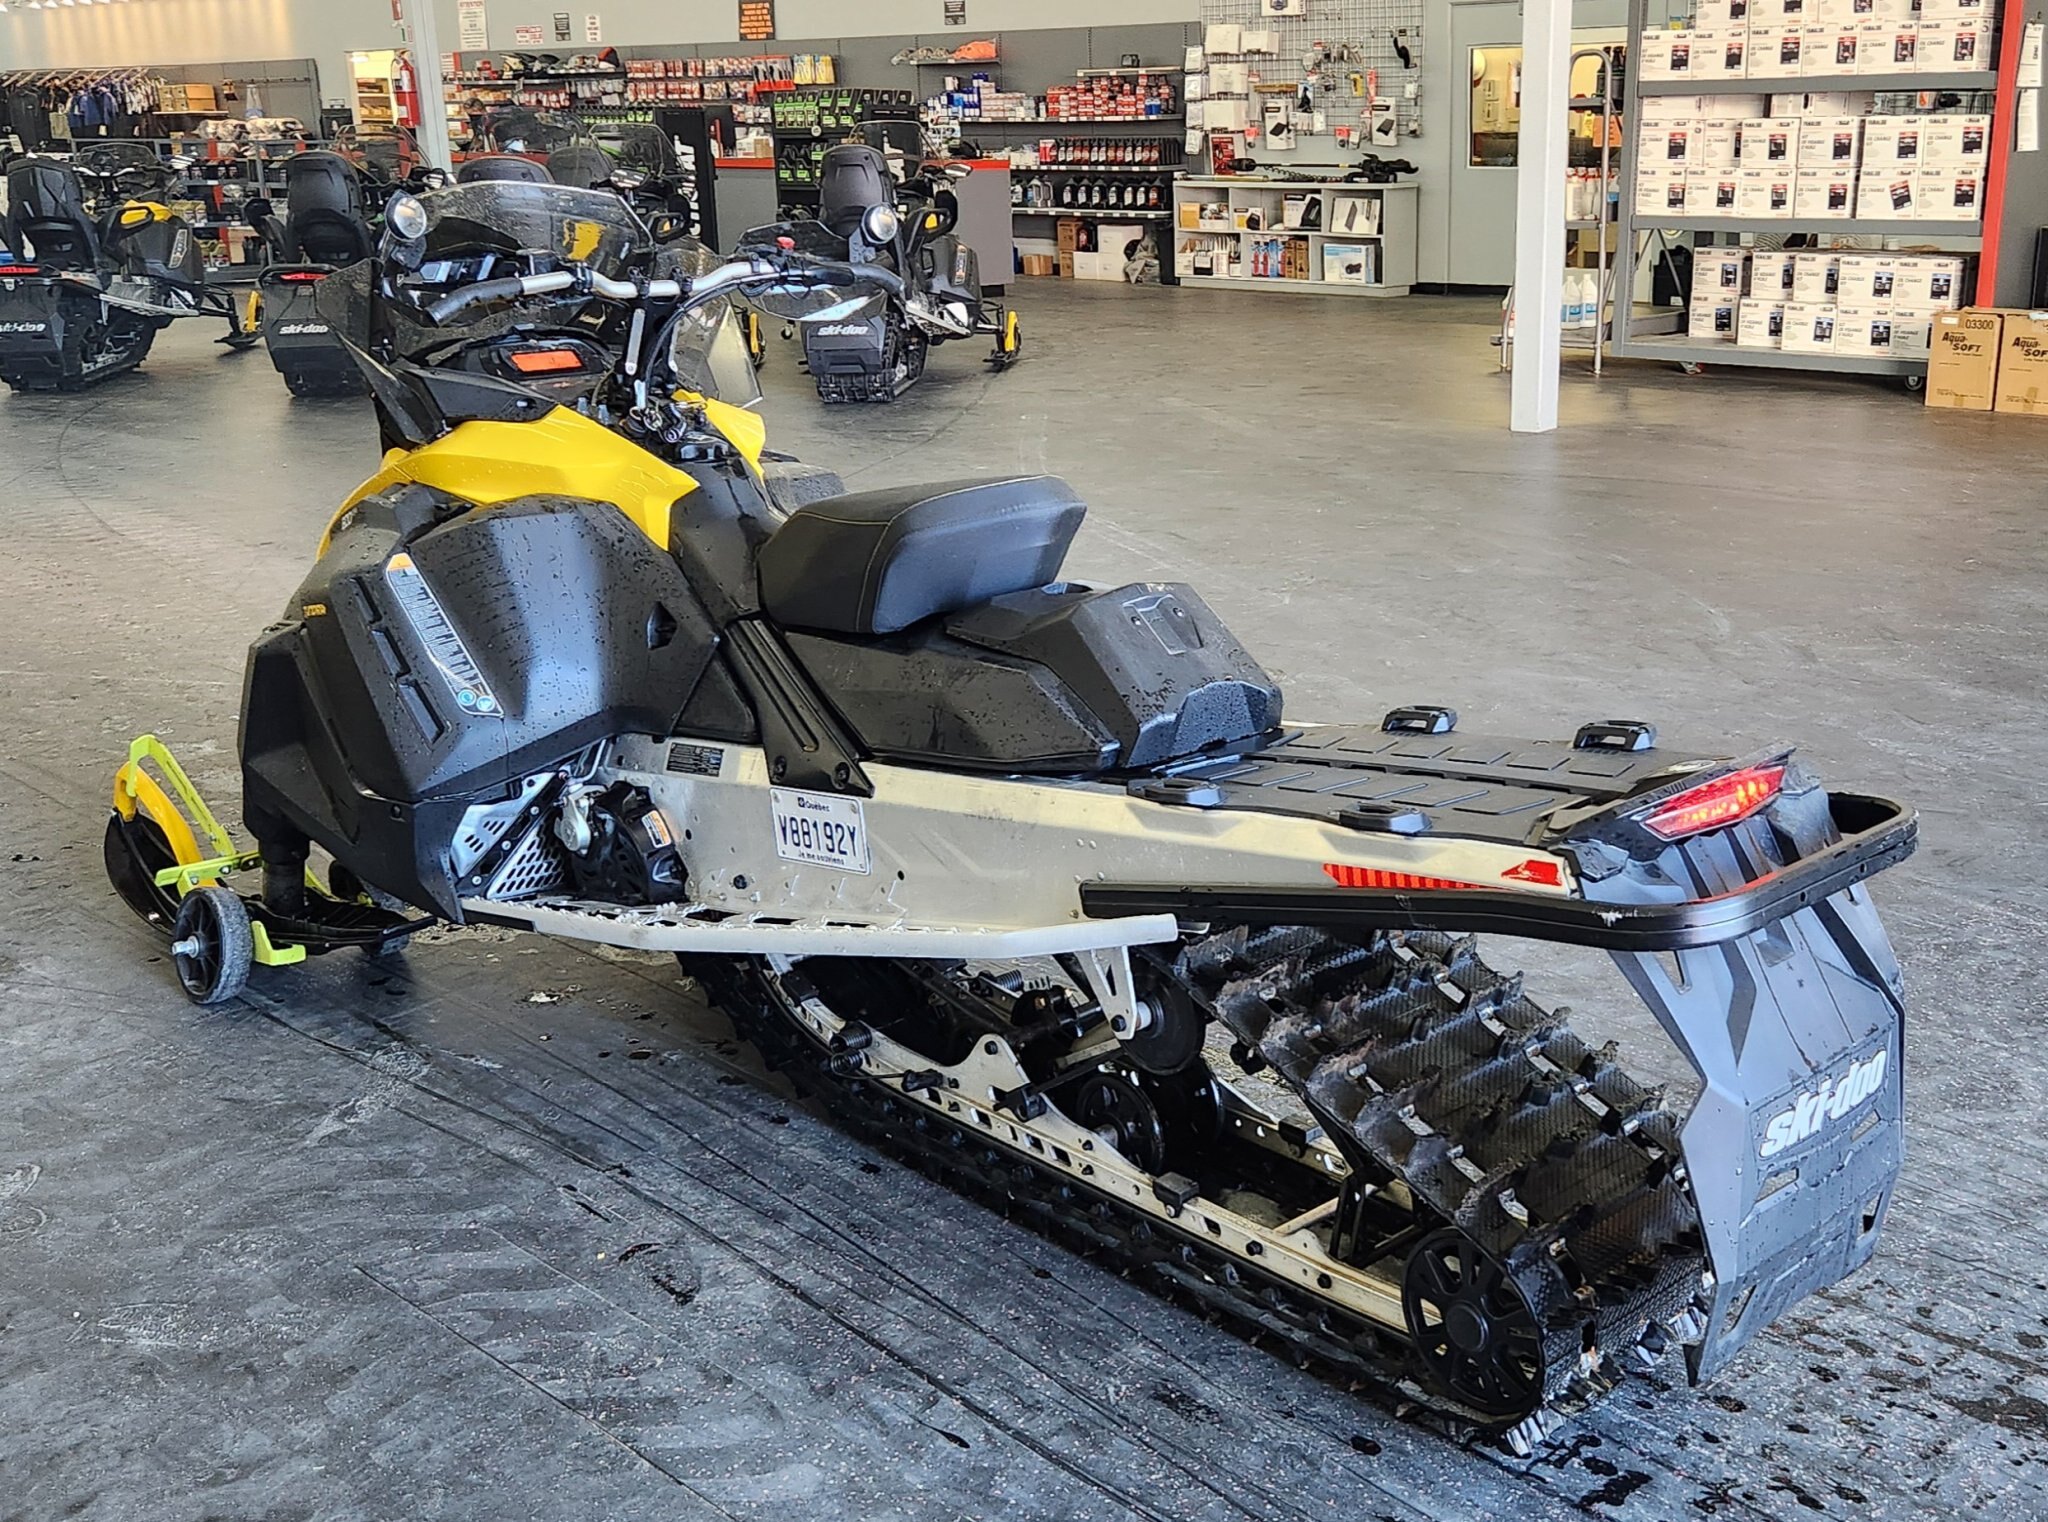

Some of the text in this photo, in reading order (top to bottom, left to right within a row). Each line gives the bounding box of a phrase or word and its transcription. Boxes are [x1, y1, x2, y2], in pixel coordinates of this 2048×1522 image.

[279, 323, 329, 335] ski-doo
[817, 324, 869, 336] ski-doo
[1965, 319, 1994, 330] 03300
[1952, 343, 1982, 352] SOFT
[778, 814, 857, 857] V88192Y
[1758, 1049, 1886, 1158] ski-doo
